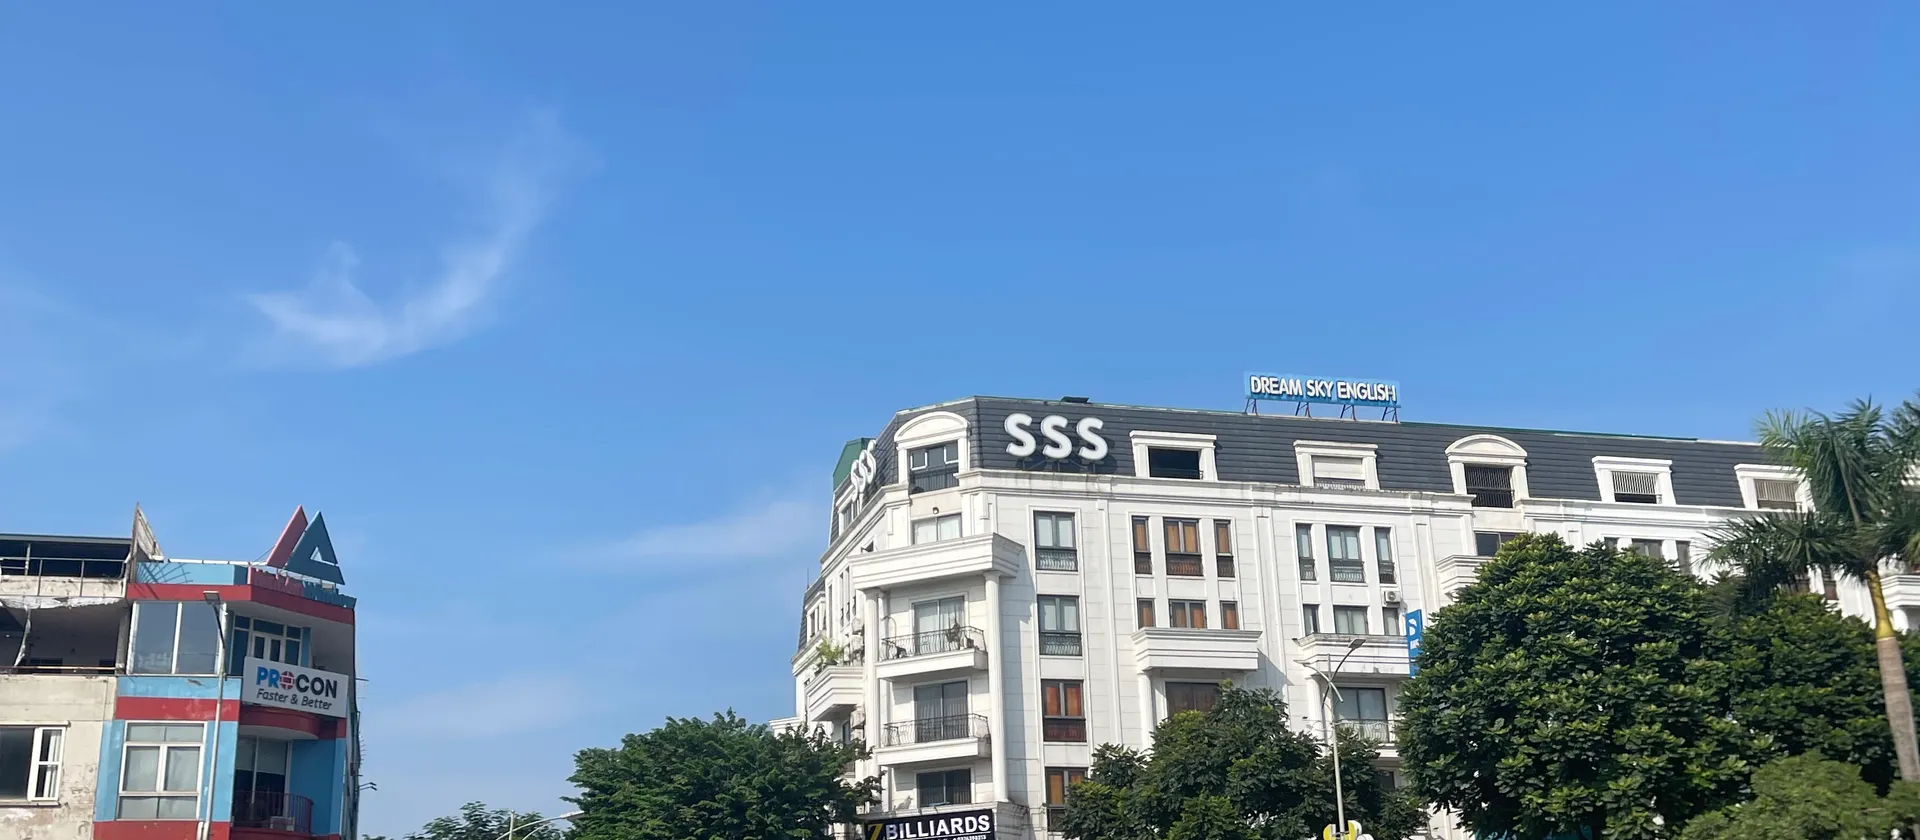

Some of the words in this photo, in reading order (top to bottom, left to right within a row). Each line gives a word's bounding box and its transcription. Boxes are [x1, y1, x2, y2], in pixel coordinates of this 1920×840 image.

[1251, 376, 1303, 396] DREAM
[1306, 378, 1334, 398] SKY
[1337, 381, 1397, 402] ENGLISH
[1004, 413, 1108, 460] SSS
[256, 666, 338, 698] PROCON
[256, 688, 288, 703] Faster
[290, 694, 299, 706] &
[301, 696, 332, 710] Better
[885, 815, 990, 839] BILLIARDS
